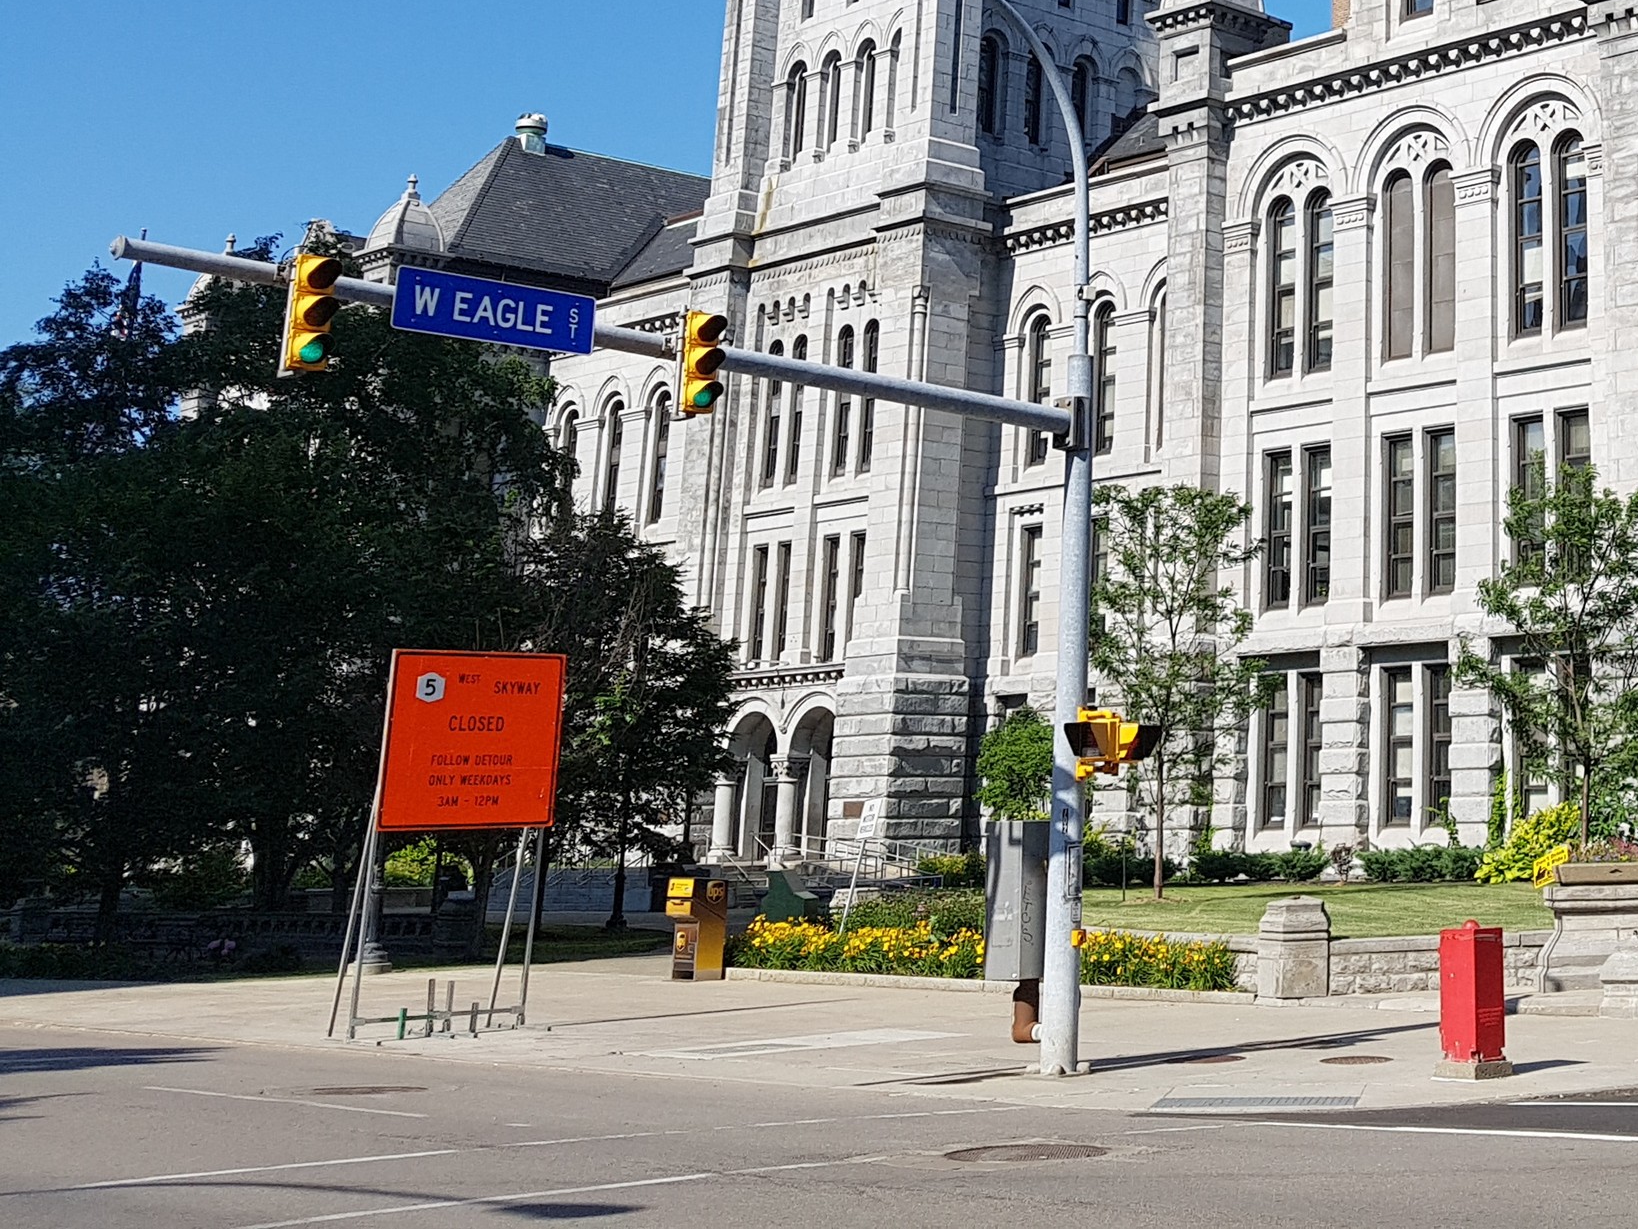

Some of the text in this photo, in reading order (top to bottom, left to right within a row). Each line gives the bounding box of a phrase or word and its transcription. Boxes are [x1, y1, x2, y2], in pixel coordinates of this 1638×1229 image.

[414, 284, 579, 339] W EAGLE ST
[424, 673, 542, 696] 5 WEST SKYWAY
[448, 715, 505, 732] CLOSED
[430, 754, 513, 766] FOLLOW DETOUR
[428, 774, 512, 786] ONLY WEEKDAYS
[437, 795, 459, 807] 3AM
[474, 795, 500, 806] 12PM
[708, 887, 725, 901] ups
